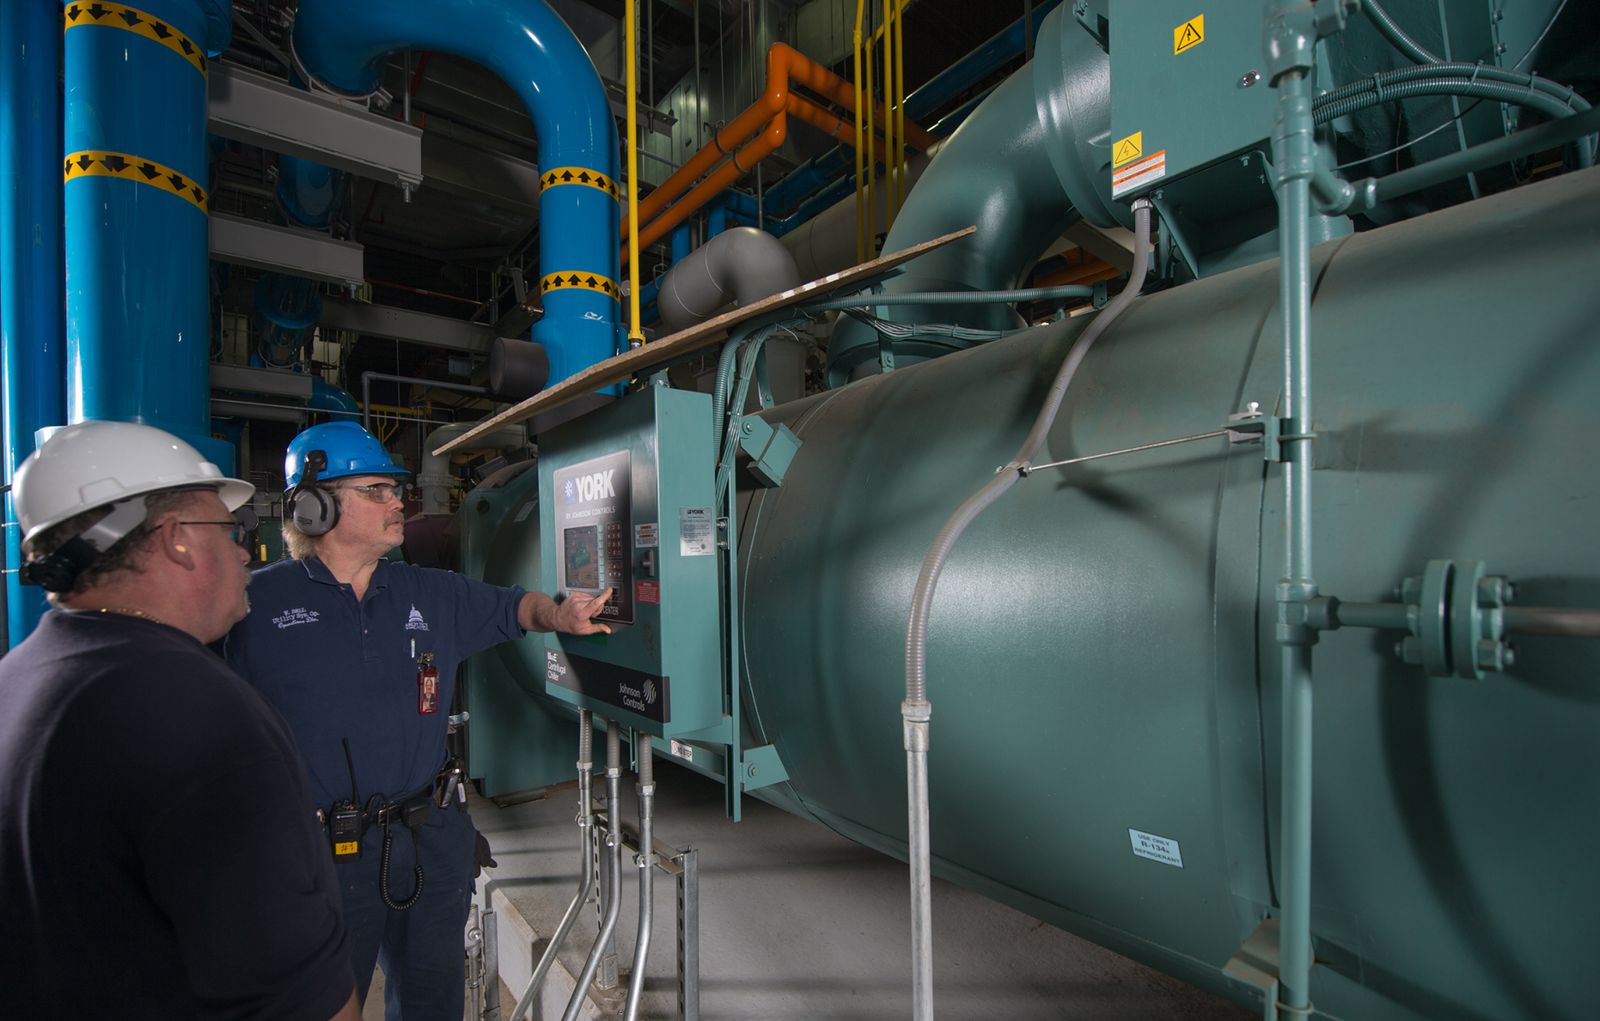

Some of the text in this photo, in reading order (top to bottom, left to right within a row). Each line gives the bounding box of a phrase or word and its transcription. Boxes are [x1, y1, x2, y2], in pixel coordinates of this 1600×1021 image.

[575, 469, 616, 503] YORK
[572, 509, 590, 519] JOHNSON
[591, 505, 616, 516] CONTROLS
[619, 682, 641, 699] Johnson
[623, 695, 645, 712] Controls
[1151, 838, 1169, 846] ONLY
[1135, 848, 1180, 863] REFRIGERANT
